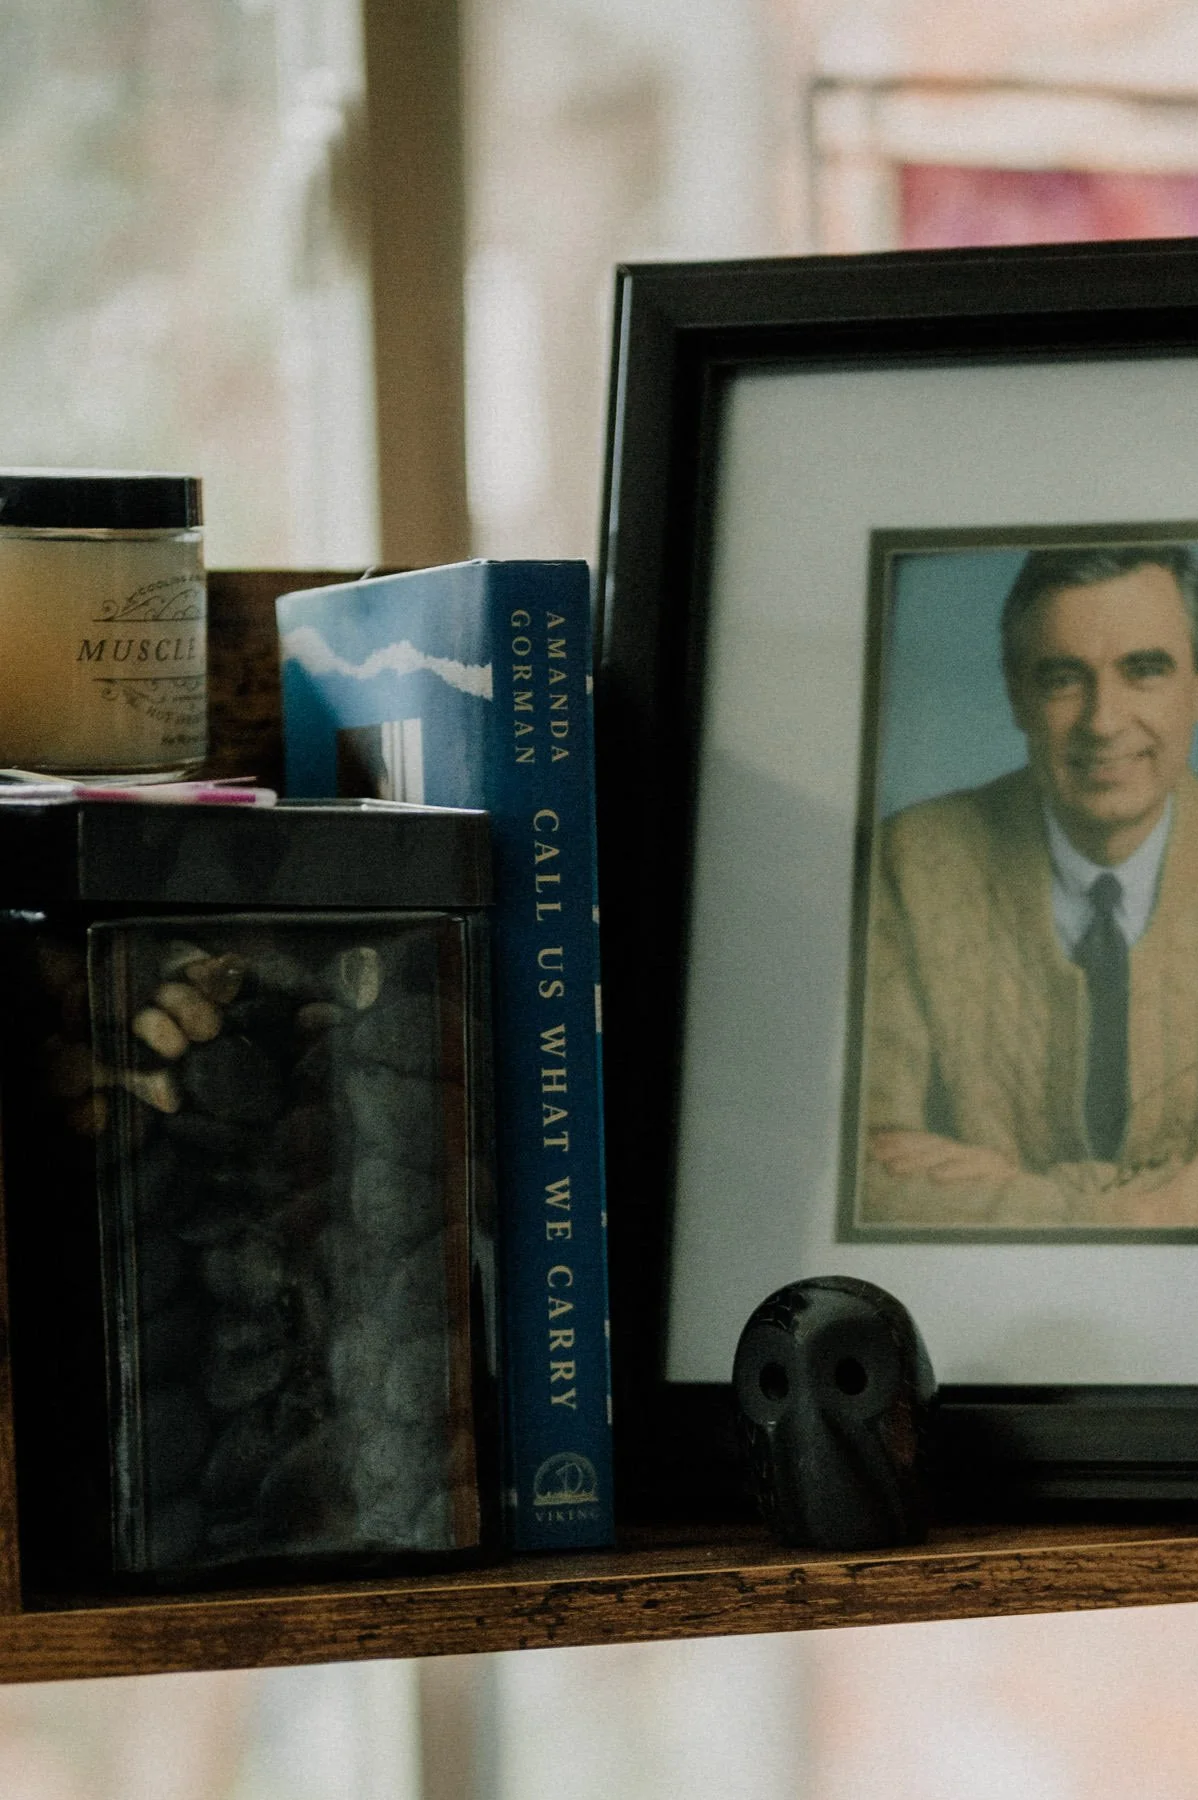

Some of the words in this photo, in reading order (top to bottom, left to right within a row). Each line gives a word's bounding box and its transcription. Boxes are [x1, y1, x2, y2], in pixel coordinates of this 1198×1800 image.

[510, 609, 536, 764] GORMAN
[545, 611, 570, 764] AMANDA
[533, 809, 562, 922] CALL
[537, 945, 565, 999] US
[539, 1023, 569, 1152] WHAT
[544, 1176, 572, 1241] WE
[547, 1265, 577, 1410] CARRY
